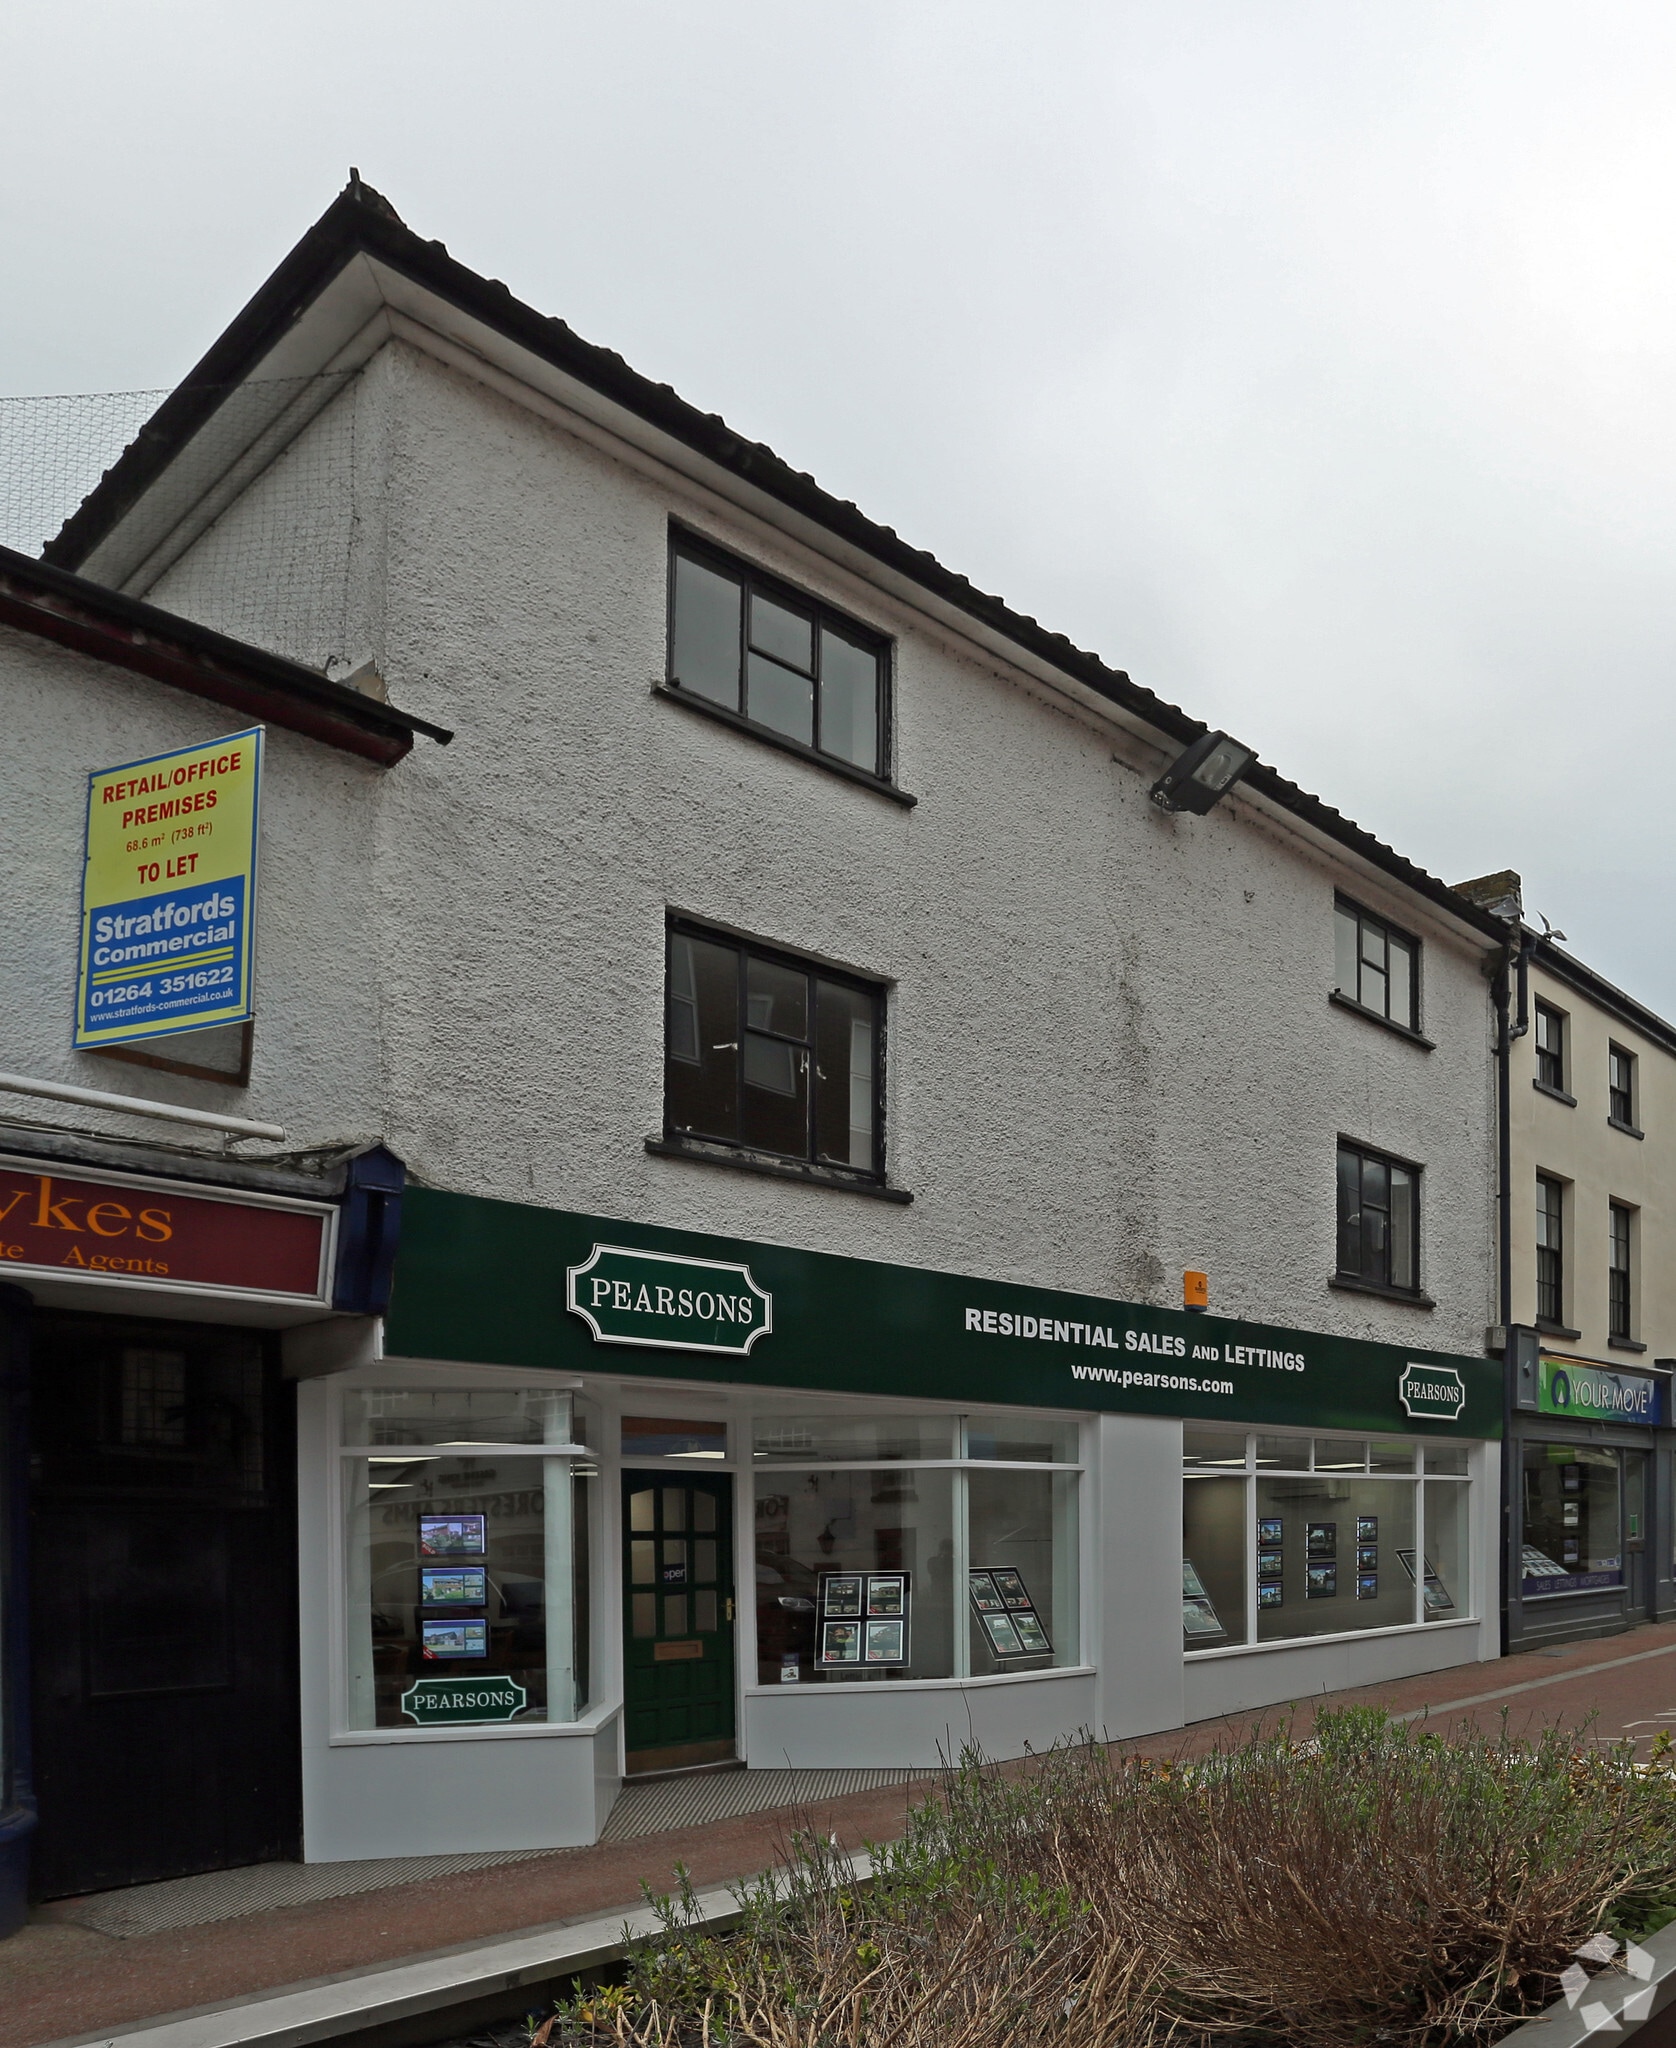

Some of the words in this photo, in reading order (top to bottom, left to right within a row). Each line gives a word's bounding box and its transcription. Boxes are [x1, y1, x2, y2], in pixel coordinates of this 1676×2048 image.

[102, 752, 241, 804] RETAIL/OFFICE
[122, 789, 217, 829] PREMISES
[126, 837, 148, 852] 68.6
[171, 828, 194, 845] (738
[138, 862, 160, 884] TO
[166, 853, 198, 879] LET
[95, 893, 235, 943] Stratfords
[93, 921, 235, 966] Commercial
[91, 982, 153, 1007] 01264
[160, 966, 234, 995] 351622
[90, 988, 234, 1023] www.stratfords-commercial.co.uk
[61, 1245, 169, 1275] Agents
[590, 1277, 753, 1324] PEARSONS
[965, 1307, 1119, 1349] RESIDENTIAL
[1125, 1330, 1186, 1357] SALES
[1192, 1345, 1219, 1361] AND
[1224, 1344, 1305, 1372] LETTINGS
[1071, 1364, 1234, 1395] www.pearsons.com
[1407, 1381, 1460, 1403] PEARSONS
[1572, 1379, 1609, 1409] YOUR
[1612, 1386, 1647, 1413] MOVE
[413, 1691, 515, 1710] PEARSONS
